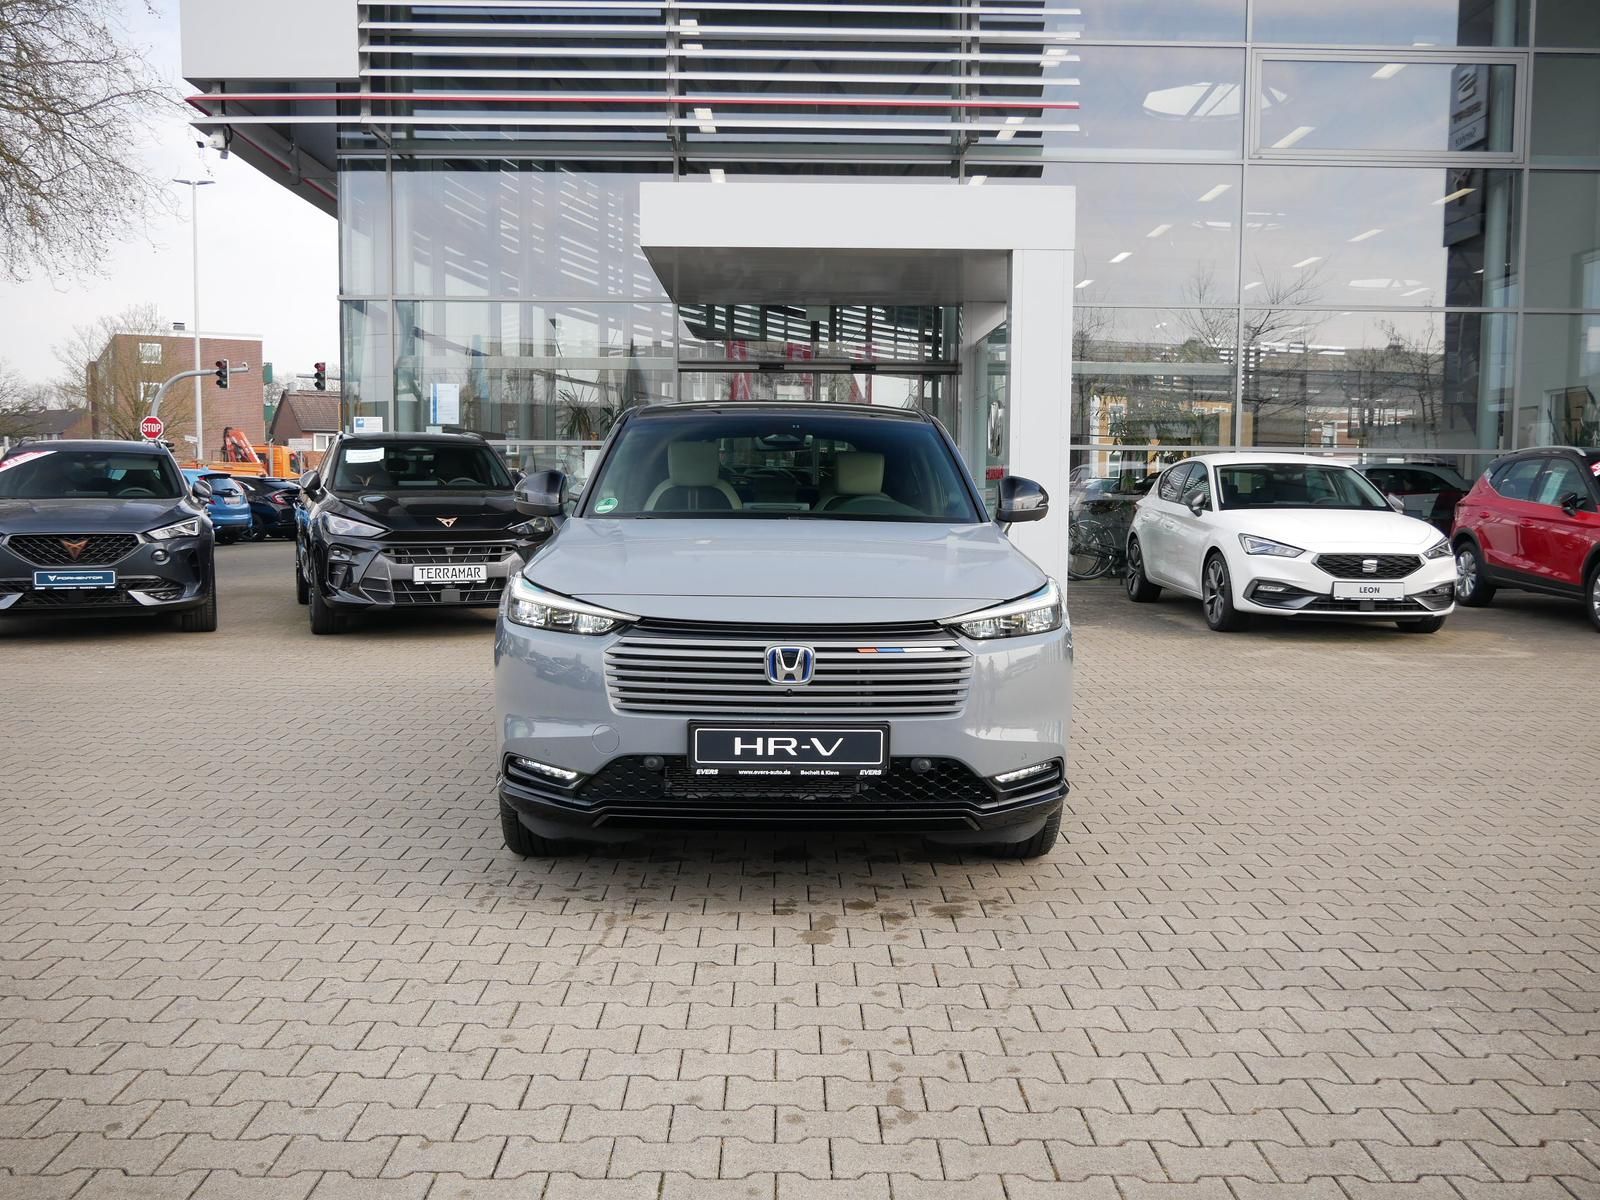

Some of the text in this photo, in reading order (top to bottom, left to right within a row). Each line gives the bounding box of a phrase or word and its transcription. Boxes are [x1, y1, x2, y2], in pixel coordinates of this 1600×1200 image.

[142, 423, 161, 432] STOP
[418, 567, 481, 579] TERRAMAR
[1359, 586, 1380, 594] LEON
[734, 736, 844, 757] HR-V
